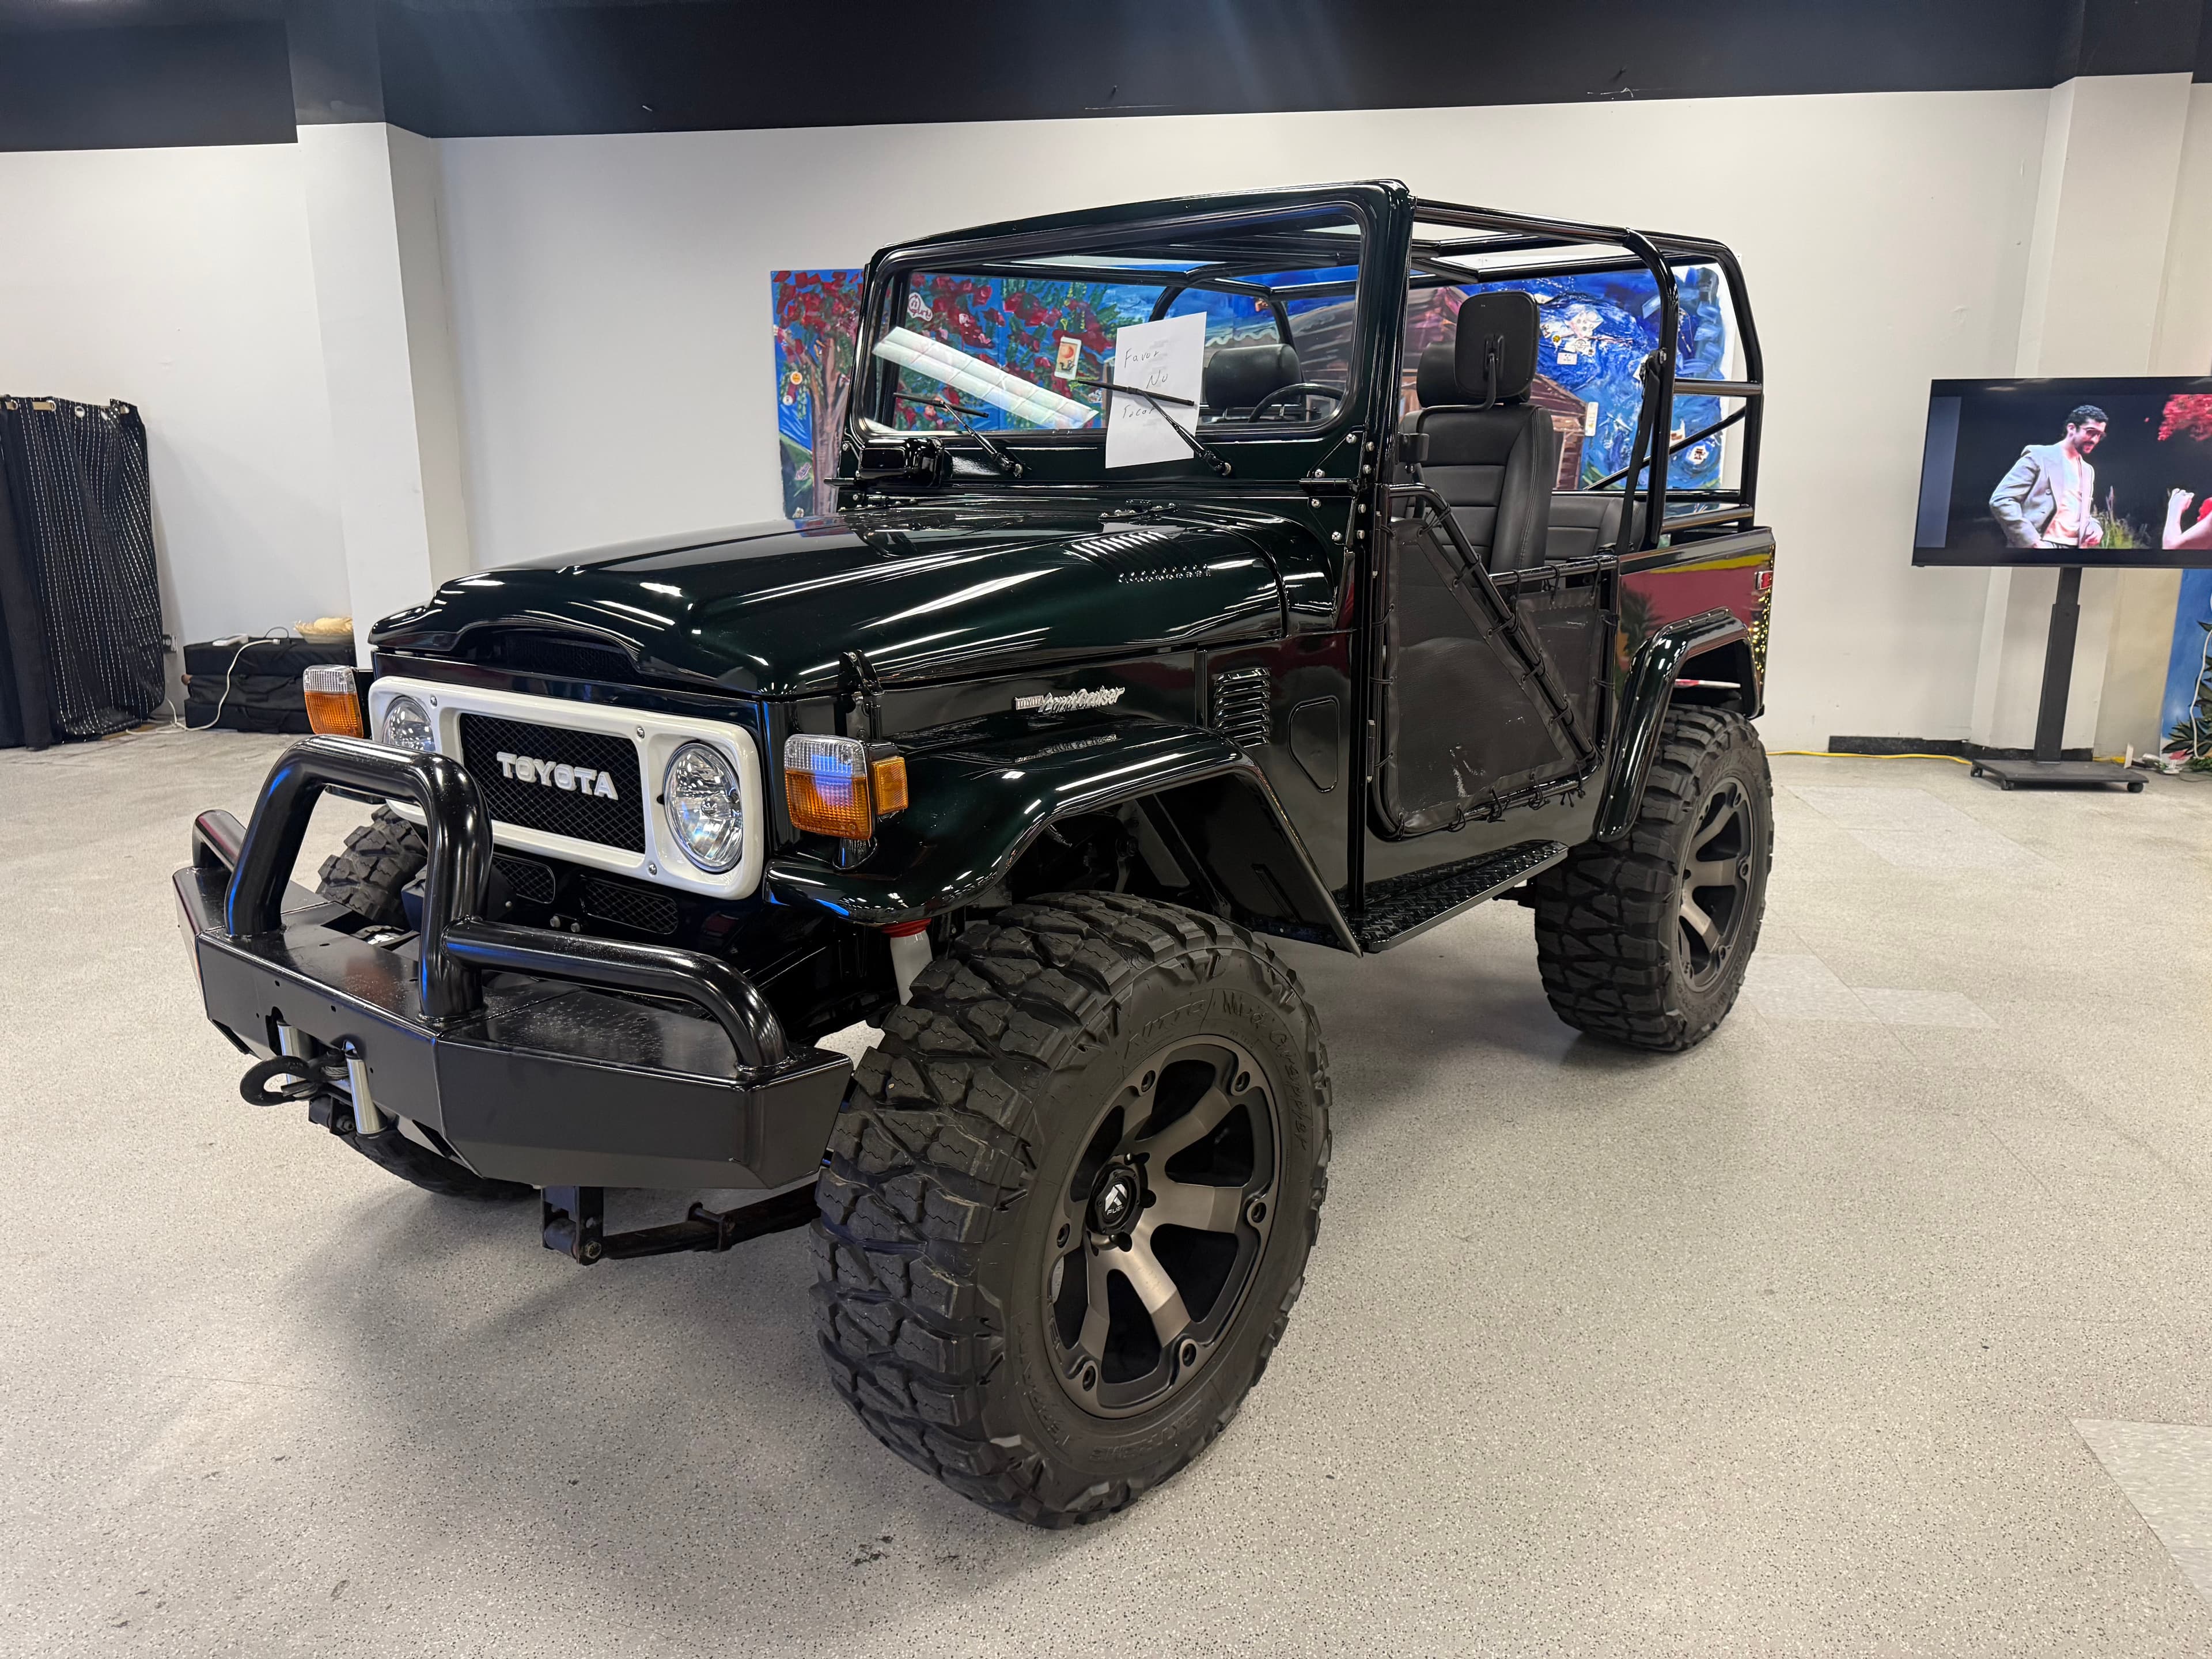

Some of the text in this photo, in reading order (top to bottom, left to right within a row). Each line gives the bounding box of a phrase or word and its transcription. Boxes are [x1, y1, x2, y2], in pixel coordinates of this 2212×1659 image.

[1124, 348, 1160, 368] Favor
[1146, 370, 1168, 389] No
[1018, 695, 1044, 709] TOYOTA
[1076, 685, 1125, 709] Cruiser
[497, 751, 619, 801] TOYOTA
